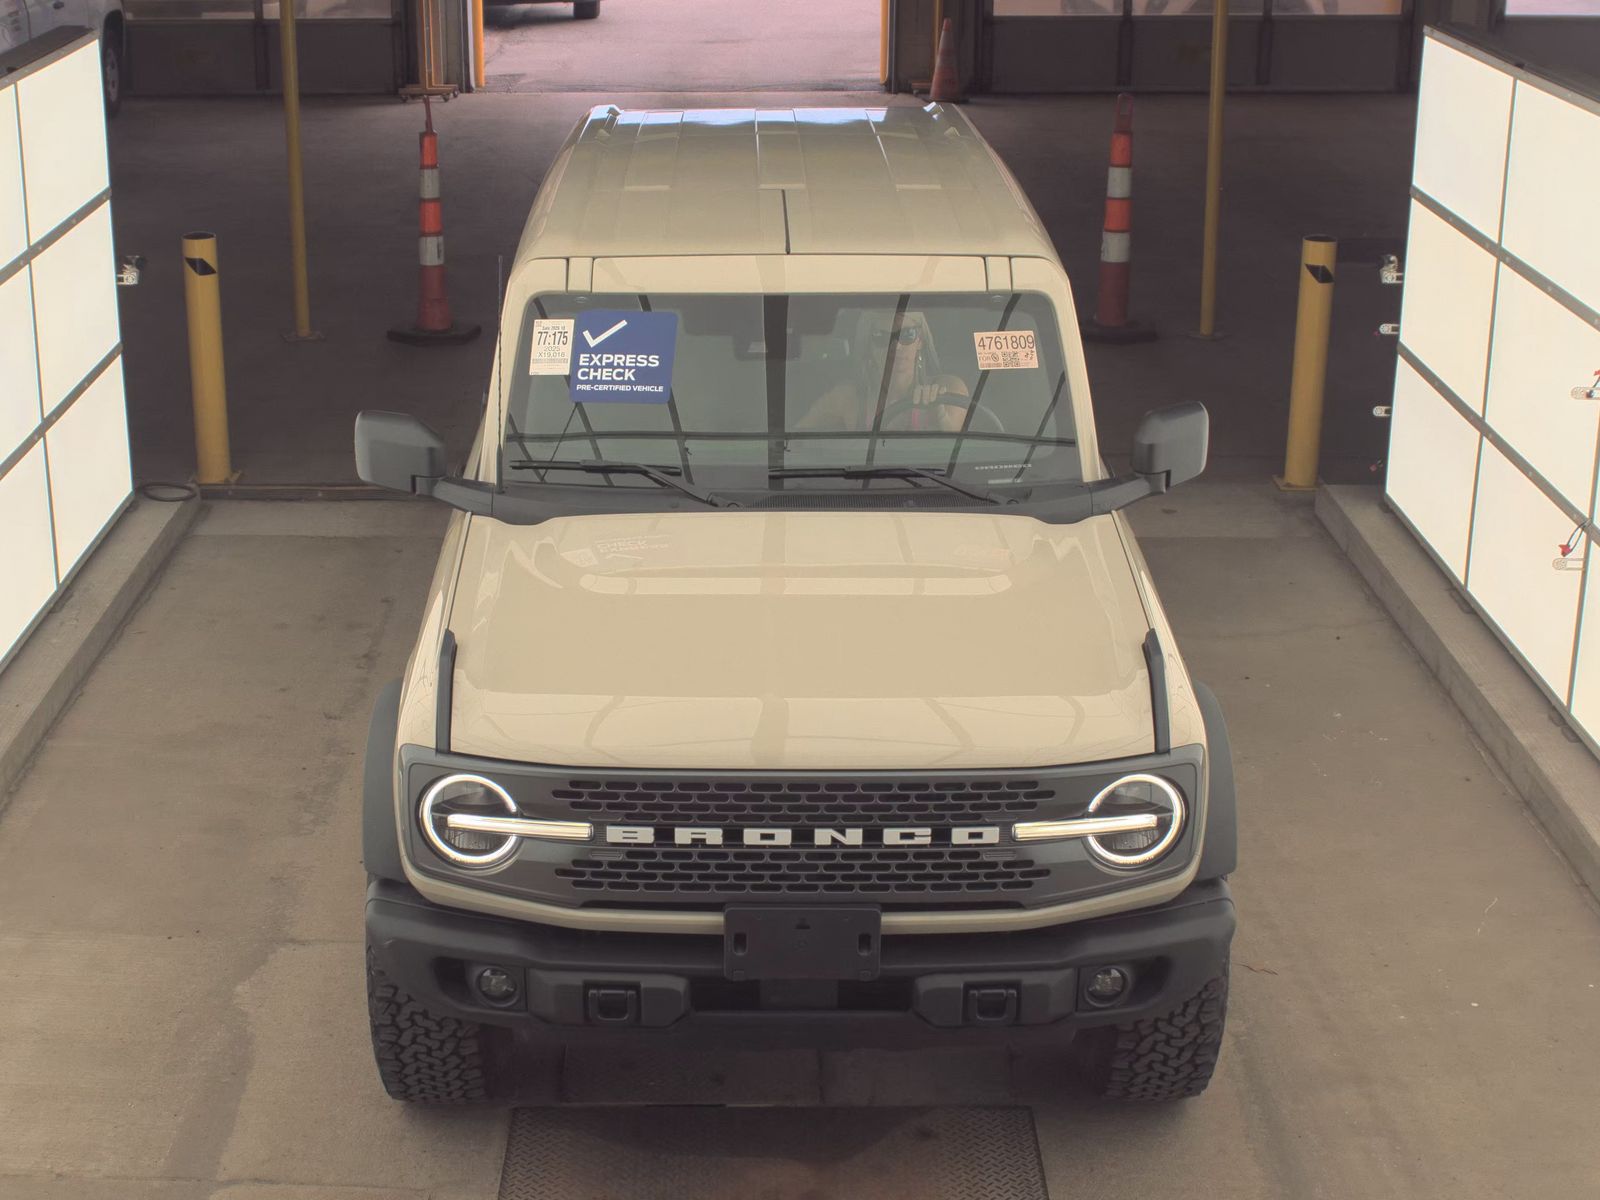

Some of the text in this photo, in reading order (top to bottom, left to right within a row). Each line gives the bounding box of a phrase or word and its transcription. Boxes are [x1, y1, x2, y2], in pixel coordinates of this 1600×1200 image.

[537, 331, 569, 346] 77:175
[978, 335, 1035, 351] 4761809
[579, 354, 660, 368] EXPRESS
[577, 368, 636, 381] CHECK
[632, 385, 664, 393] VEHICLE
[606, 826, 1000, 846] BRONCO
